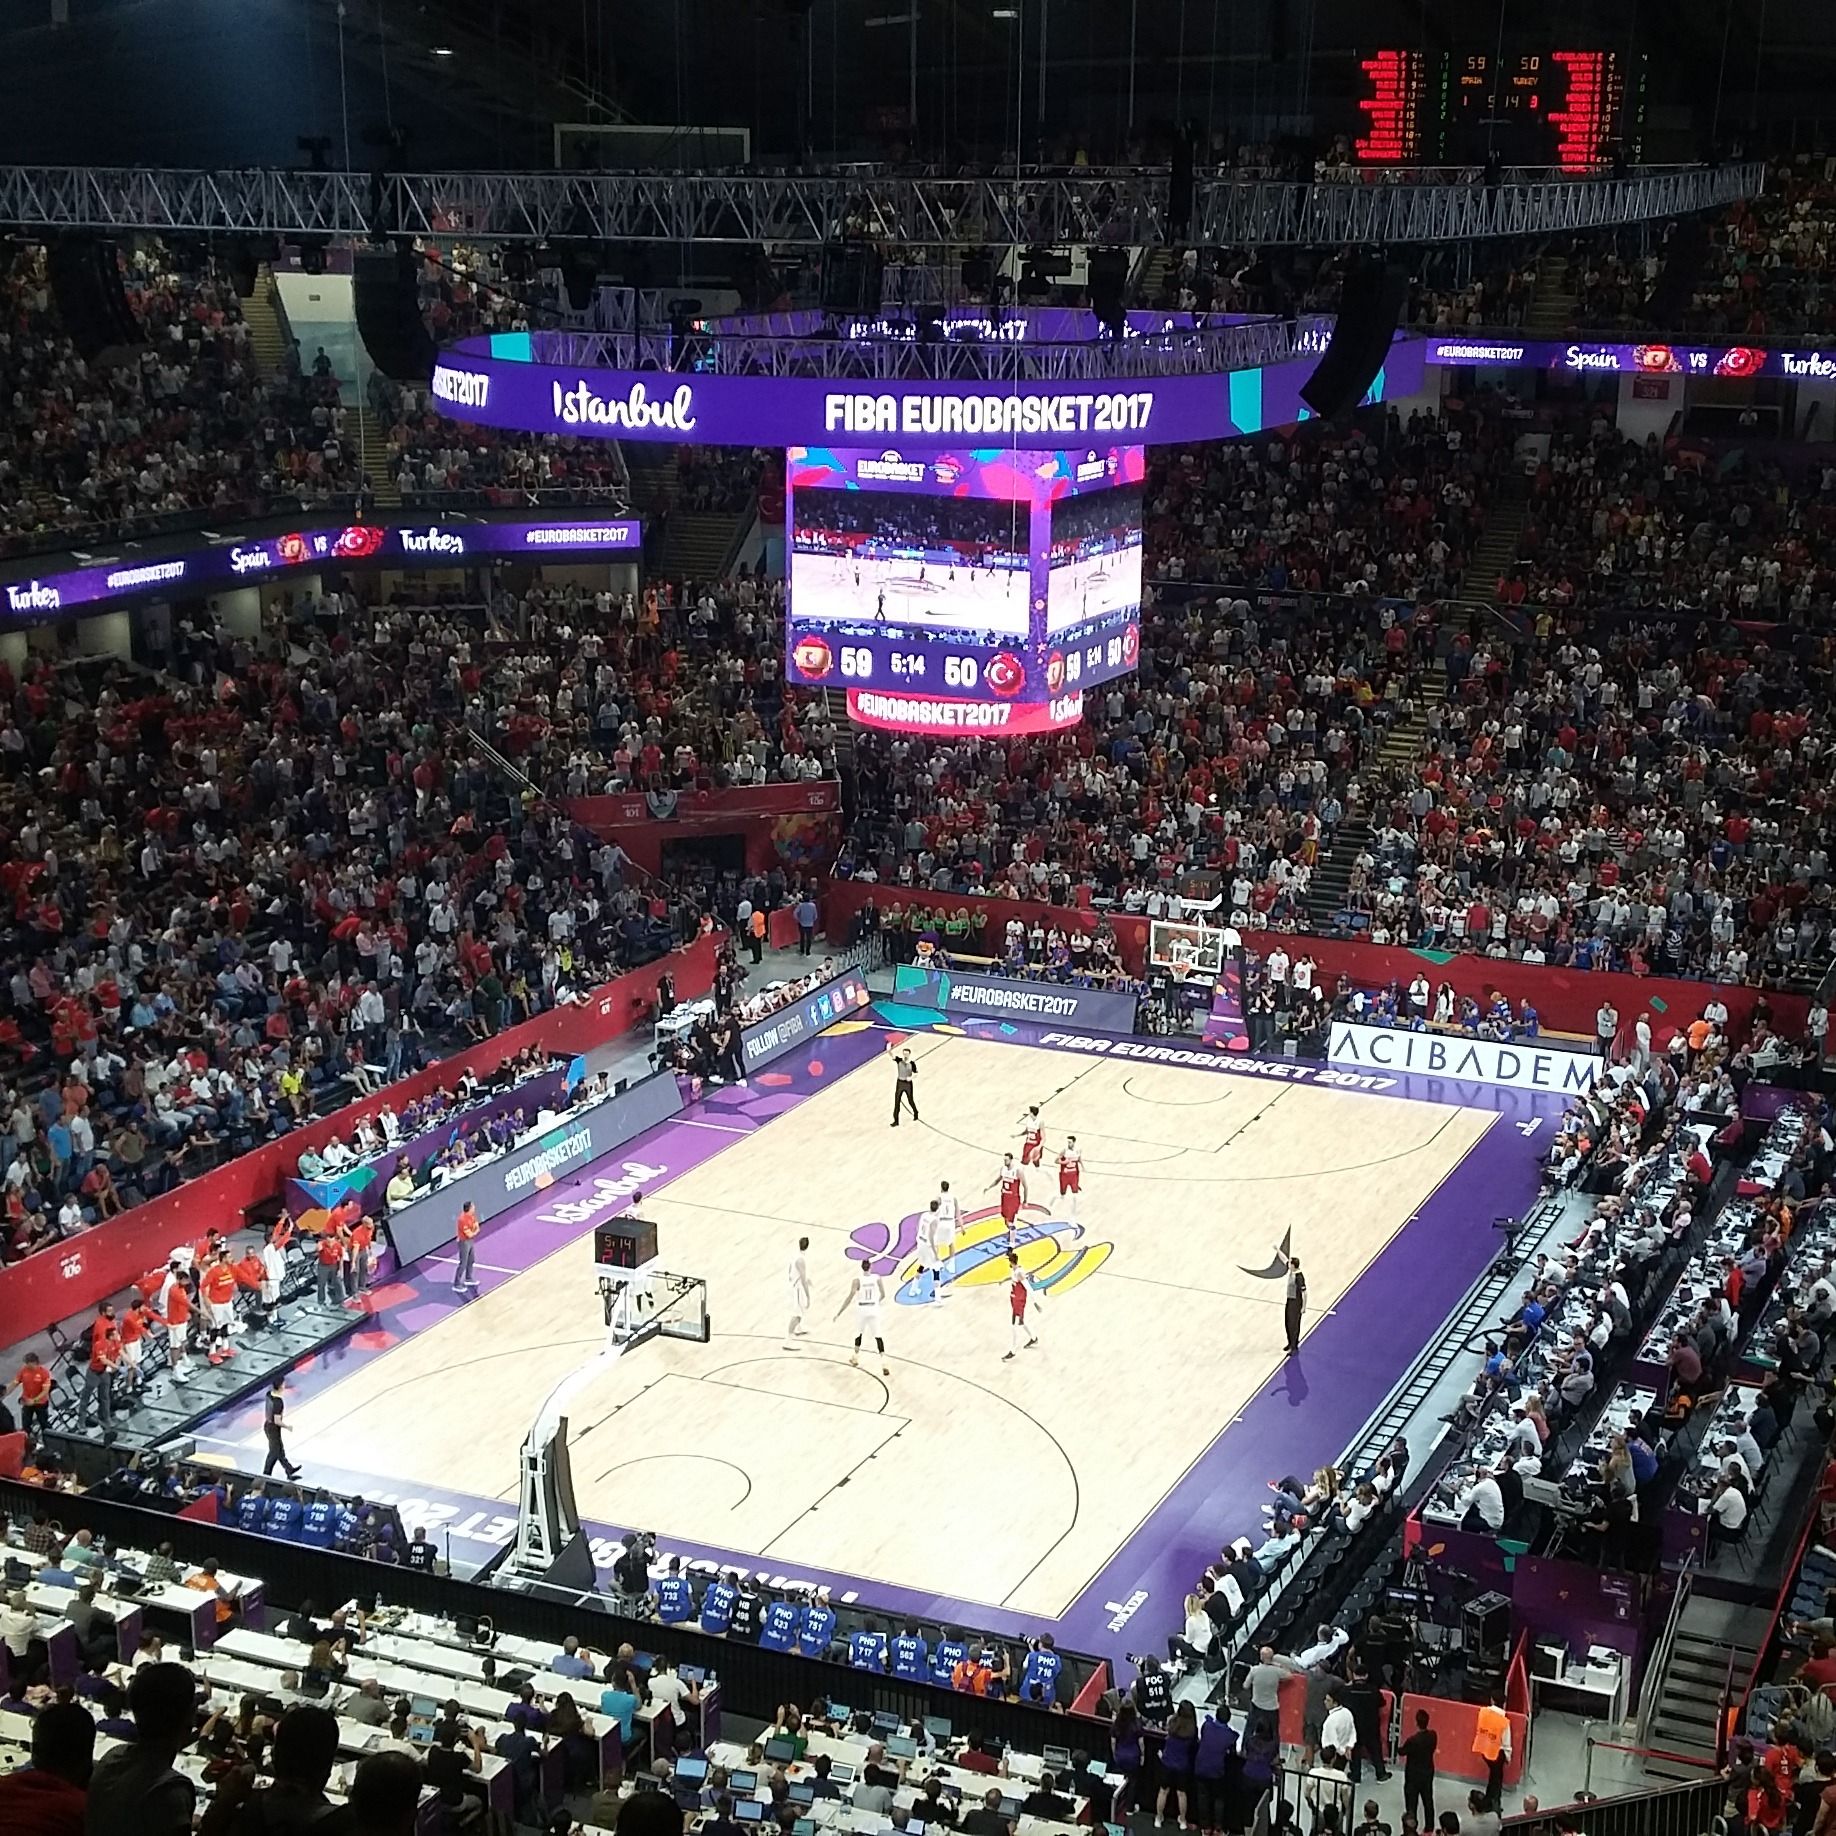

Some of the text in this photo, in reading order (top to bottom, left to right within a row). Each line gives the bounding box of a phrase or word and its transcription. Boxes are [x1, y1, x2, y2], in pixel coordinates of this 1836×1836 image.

[1468, 57, 1486, 70] 59
[1521, 57, 1539, 70] 50
[1505, 95, 1519, 108] 14
[1437, 345, 1523, 360] #EUROBASKET2017
[1565, 346, 1621, 369] Spain
[1690, 353, 1708, 368] VS
[553, 382, 697, 431] Istanbul
[825, 393, 1153, 433] FIBA EUROBASKET 2017
[527, 527, 629, 544] #EUROBASKET2017
[231, 529, 464, 573] Spain VS Turkey
[108, 562, 184, 588] #EUROBASKET2017
[6, 584, 60, 609] Turkey
[1066, 651, 1081, 682] 59
[1107, 637, 1122, 667] 50
[840, 647, 978, 687] 59 5:14 50
[857, 692, 1012, 726] #EUROBASKET2017
[951, 985, 1078, 1016] #EUROBASKET2017
[746, 1014, 803, 1059] FOLLOW @FIBA
[1039, 1032, 1399, 1090] FIBA EUROBASKET 2017
[1333, 1028, 1596, 1091] ACIBADEM
[504, 1127, 592, 1192] #EUROBASKET2017
[535, 1162, 668, 1225] Istanbul
[63, 1263, 82, 1279] 106
[275, 1502, 291, 1512] PHO
[311, 1503, 328, 1511] PHO
[342, 1511, 358, 1523] PHO
[410, 1555, 425, 1564] 321
[662, 1581, 680, 1590] PHO
[715, 1586, 734, 1599] PHO
[713, 1598, 728, 1610] 743
[739, 1600, 750, 1609] HB
[775, 1607, 793, 1620] PHO
[809, 1611, 828, 1622] PHO
[808, 1620, 823, 1632] 751
[858, 1635, 877, 1647] PHO
[898, 1639, 917, 1650] PHO
[858, 1647, 873, 1657] 717
[943, 1646, 962, 1657] PHO
[1037, 1655, 1056, 1667] PHO
[1144, 1675, 1164, 1686] FOC
